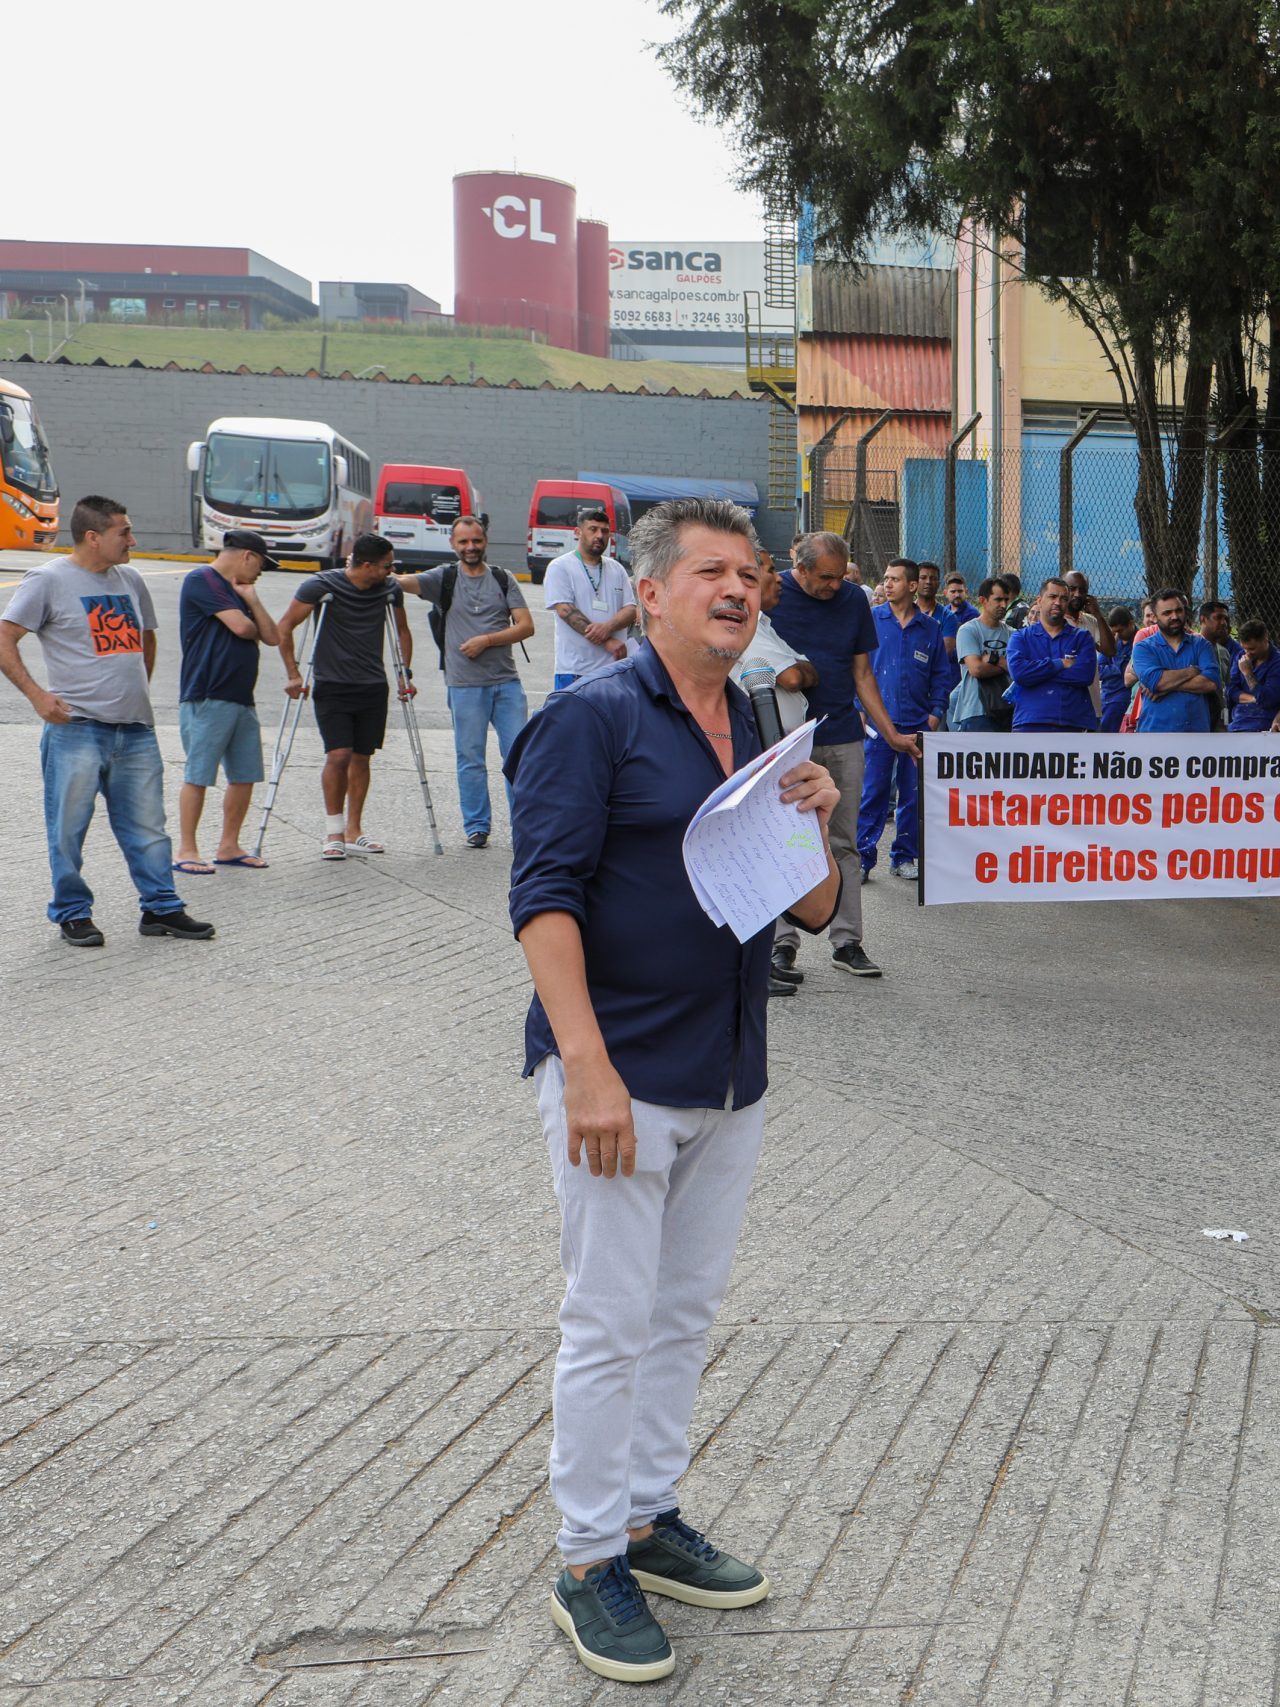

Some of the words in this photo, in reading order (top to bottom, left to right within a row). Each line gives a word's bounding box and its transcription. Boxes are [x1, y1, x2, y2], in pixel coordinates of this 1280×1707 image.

[493, 195, 556, 244] CL
[628, 250, 722, 273] sanca
[676, 273, 722, 284] GALPÕES
[614, 310, 641, 321] 5092
[644, 311, 672, 322] 6683
[692, 312, 721, 323] 3246
[95, 632, 143, 652] DAN
[937, 752, 1086, 779] DIGNIDADE:
[1092, 751, 1142, 779] Não
[1149, 756, 1180, 779] se
[949, 788, 1152, 827] Lutaremos
[1161, 787, 1265, 828] pelos
[975, 852, 998, 884] e
[1008, 844, 1158, 884] direitos
